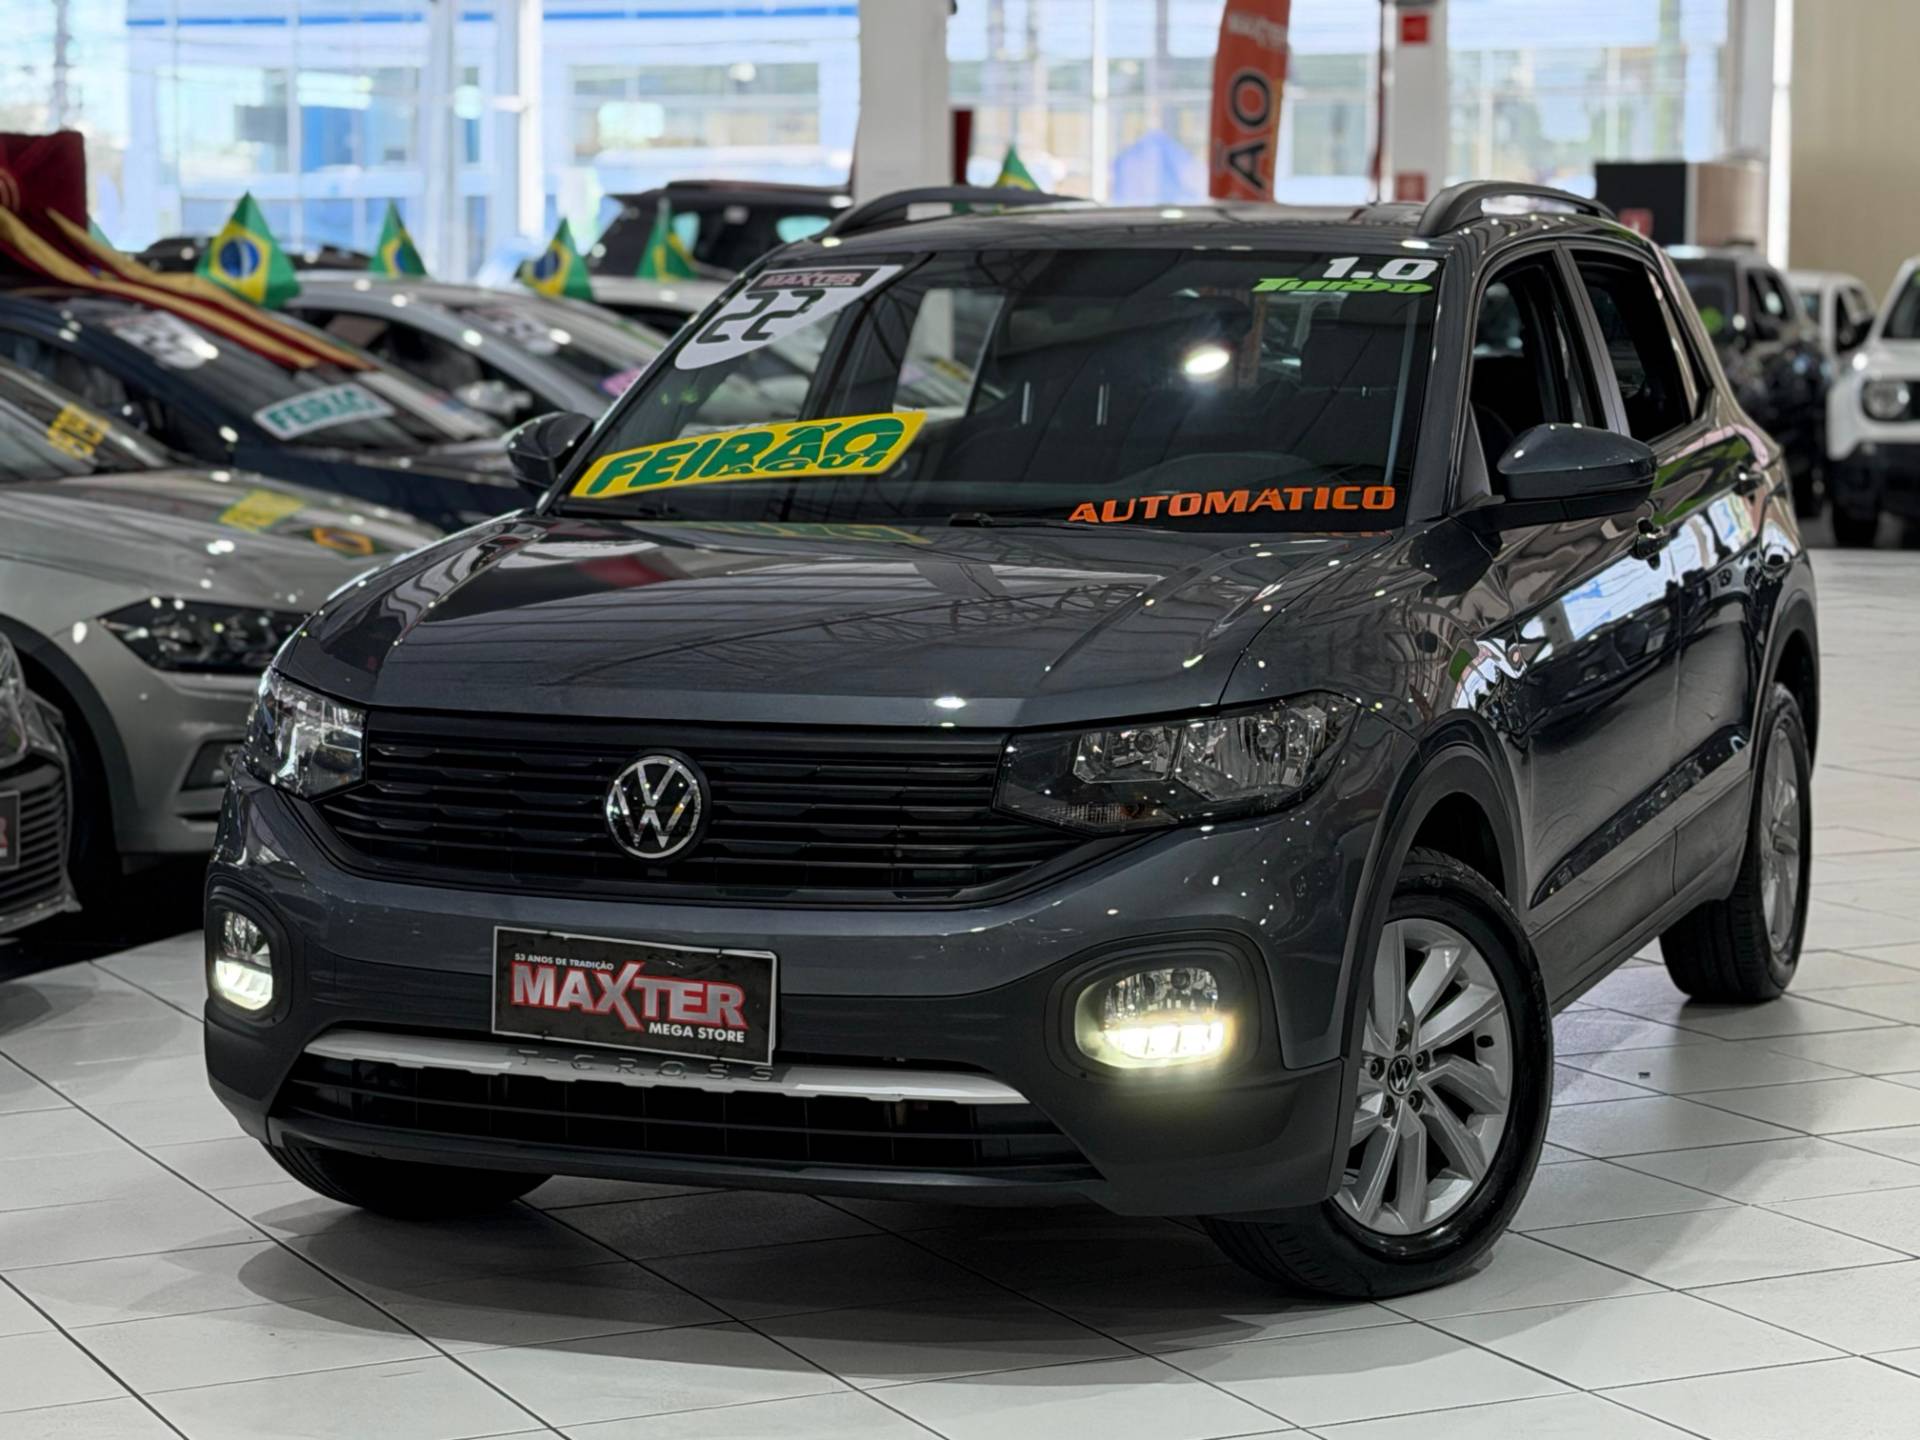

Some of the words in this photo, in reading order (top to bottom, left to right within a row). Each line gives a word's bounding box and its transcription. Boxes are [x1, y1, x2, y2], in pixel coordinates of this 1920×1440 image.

[1322, 257, 1438, 280] 1.0
[696, 290, 826, 344] 22
[586, 418, 905, 495] FEIRÃO
[528, 954, 553, 964] ANOS
[555, 957, 567, 966] DE
[569, 958, 614, 971] TRADIÇÃO
[510, 961, 749, 1032] MAXTER
[648, 1022, 694, 1038] MEGA
[697, 1027, 745, 1043] STORE
